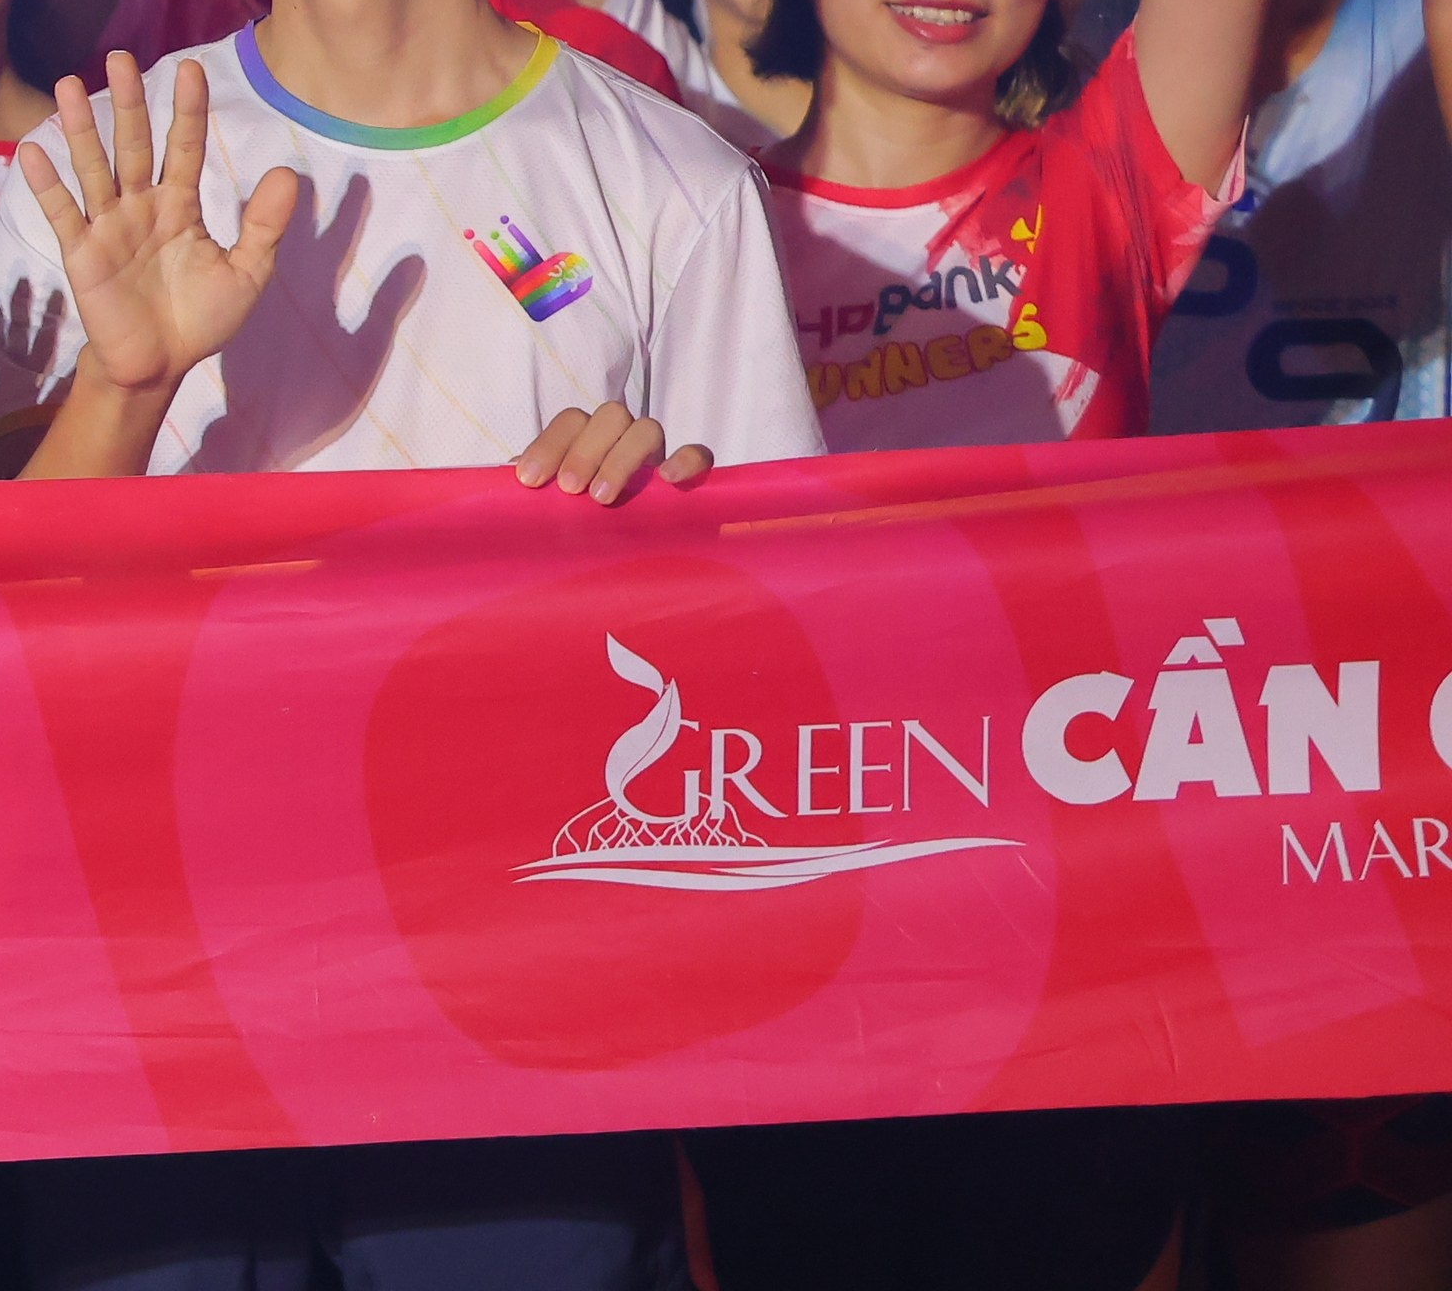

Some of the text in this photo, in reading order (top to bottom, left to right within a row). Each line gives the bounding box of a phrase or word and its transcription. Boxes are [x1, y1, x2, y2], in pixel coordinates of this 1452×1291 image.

[806, 303, 1048, 410] UNNERS
[605, 677, 991, 824] GREEN
[1021, 617, 1380, 805] CẦN
[1282, 816, 1452, 885] MAR
